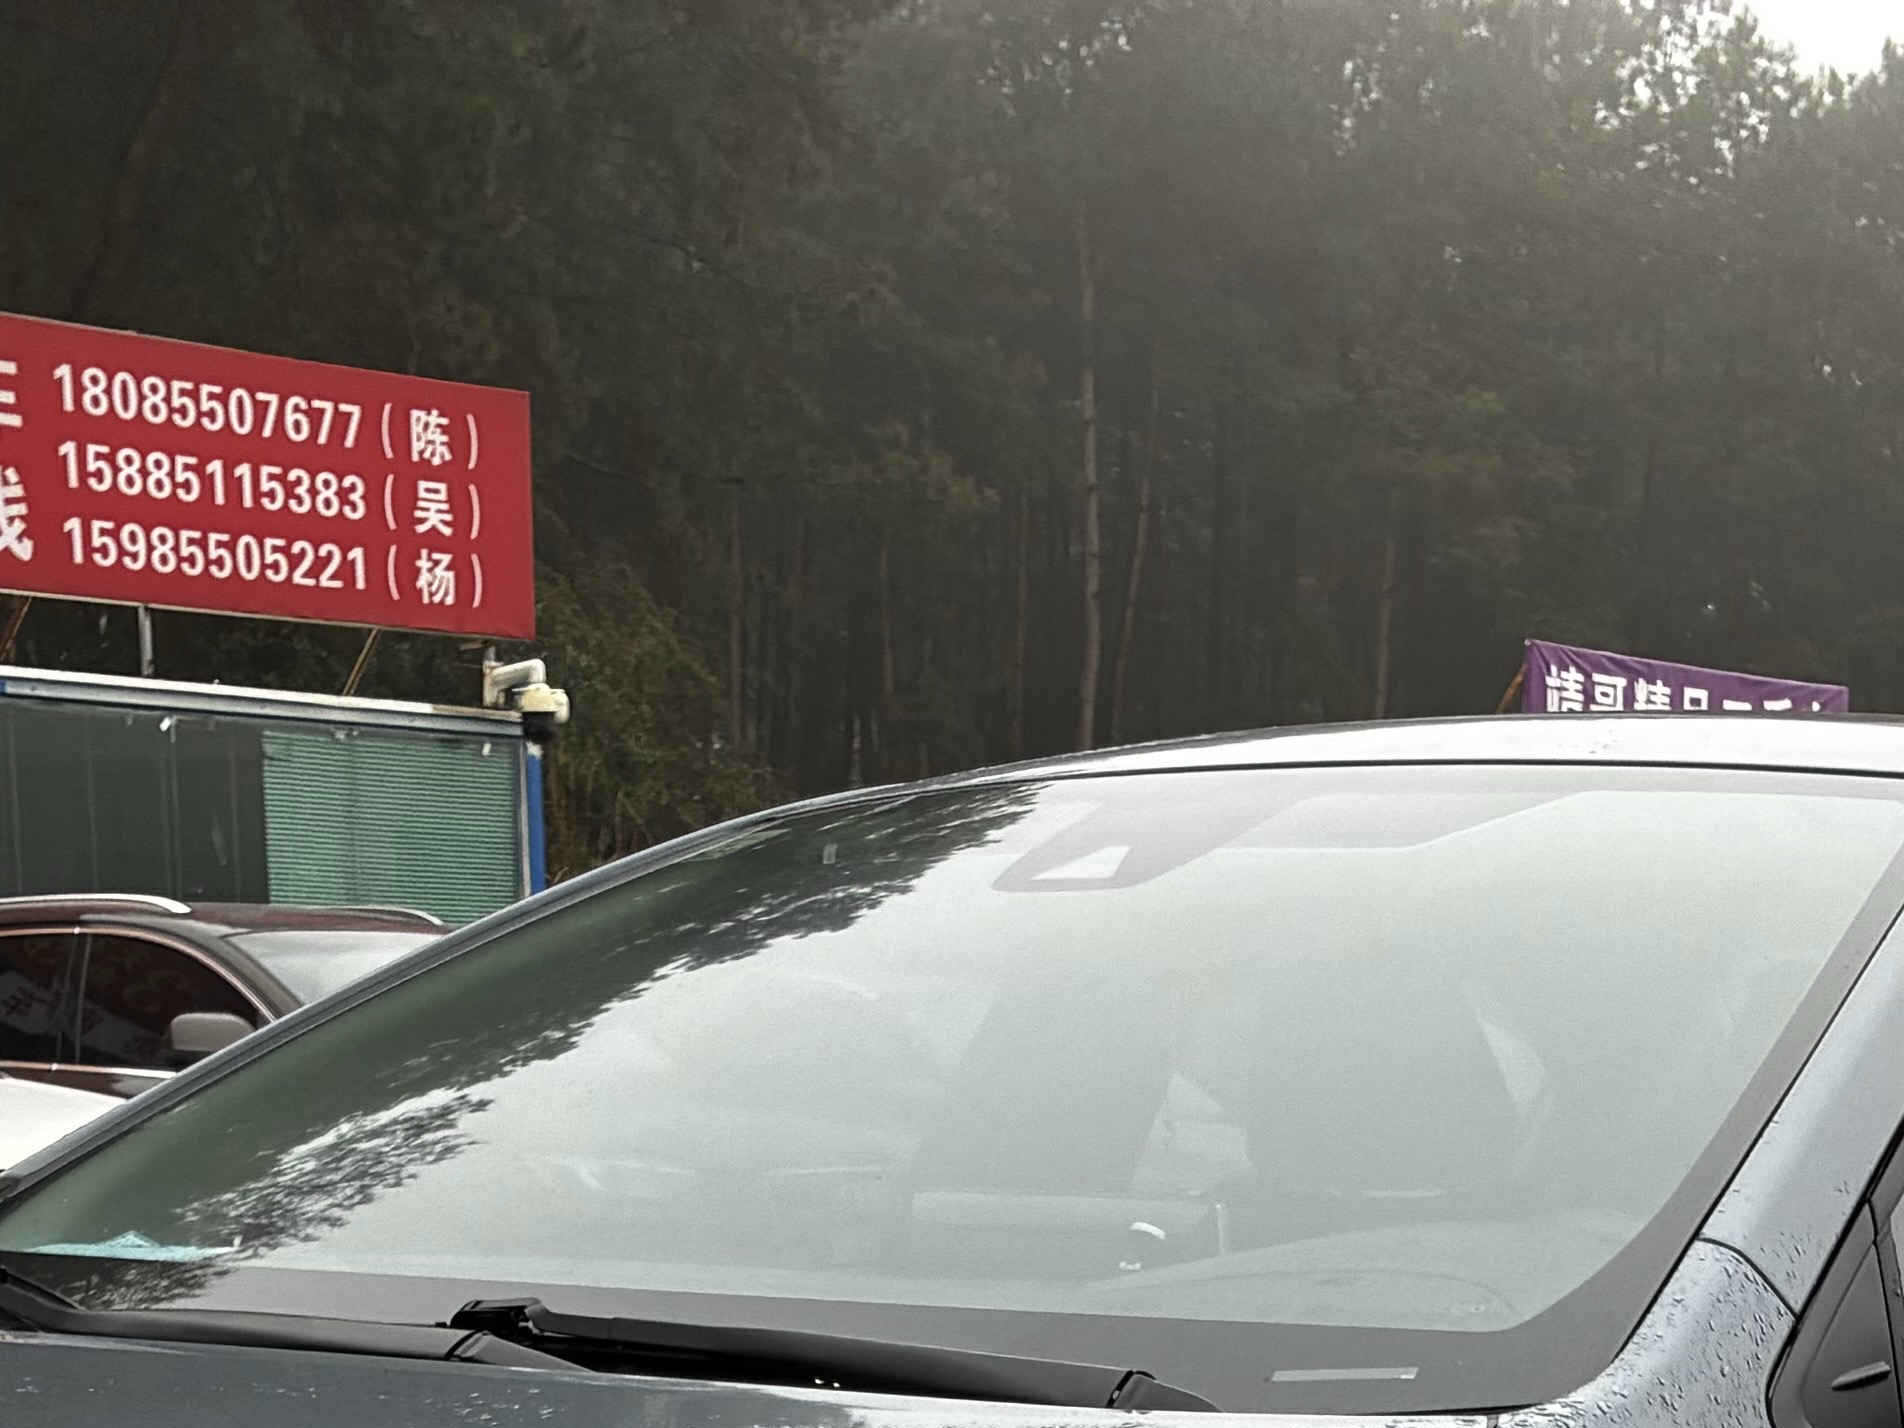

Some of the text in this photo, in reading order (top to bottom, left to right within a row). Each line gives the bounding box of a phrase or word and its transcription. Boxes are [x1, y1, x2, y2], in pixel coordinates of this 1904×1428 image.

[53, 363, 362, 449] 18085507677
[58, 440, 367, 521] 15885115383
[63, 516, 366, 590] 15985505221
